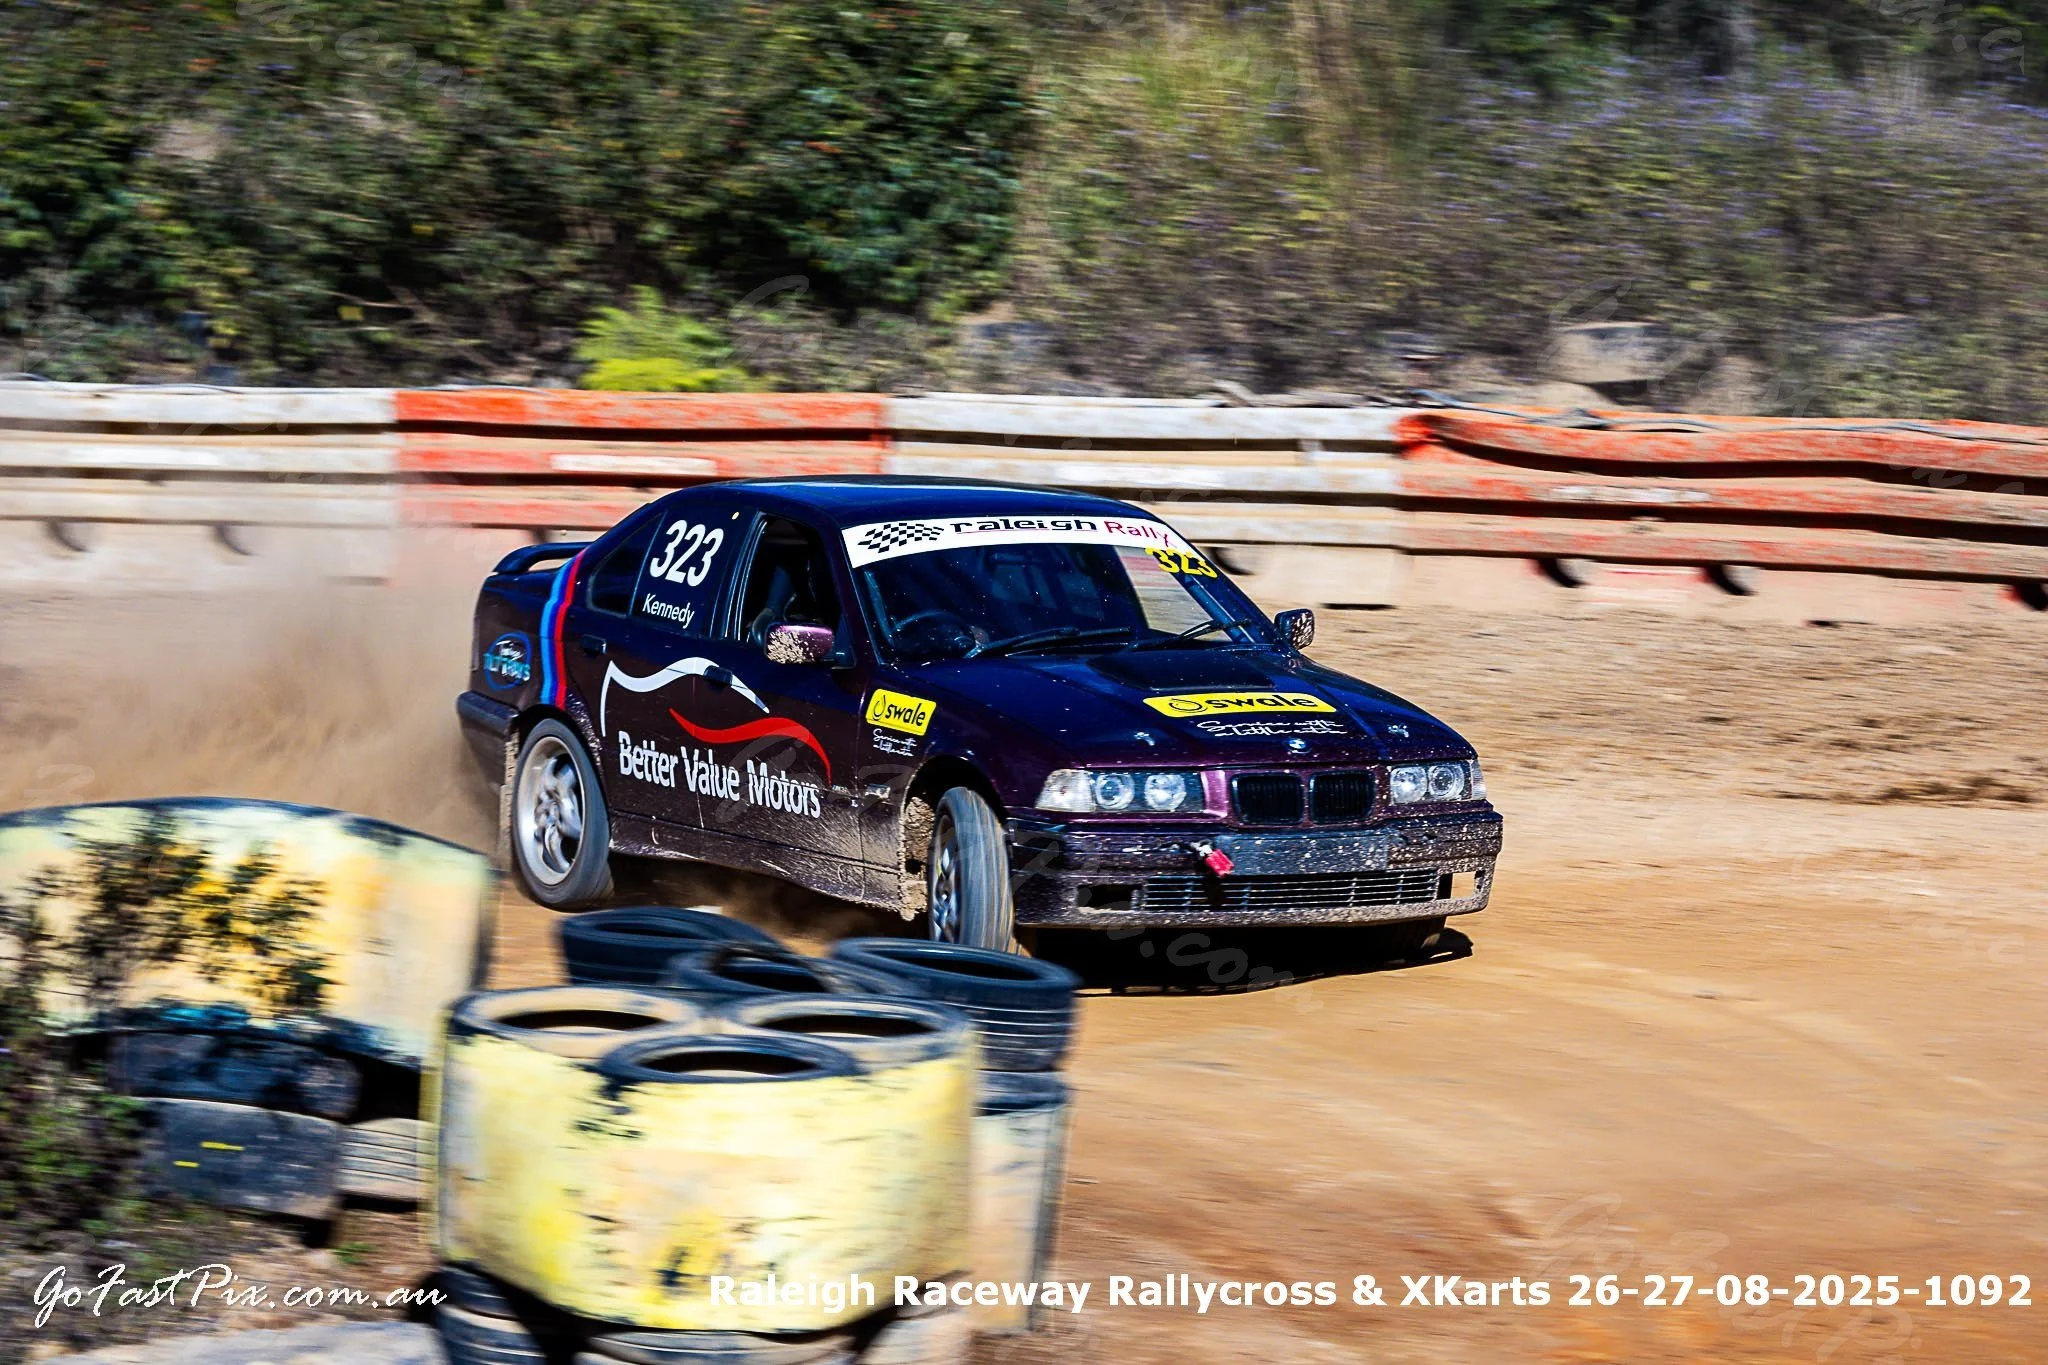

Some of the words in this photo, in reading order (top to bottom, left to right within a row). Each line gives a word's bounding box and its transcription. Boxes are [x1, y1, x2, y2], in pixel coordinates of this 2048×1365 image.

[950, 519, 1097, 533] raleigh
[1104, 520, 1173, 547] Rally
[650, 520, 724, 587] 323
[1145, 547, 1218, 579] 323
[642, 592, 695, 629] Kennedy
[885, 703, 926, 726] swale
[1205, 694, 1318, 709] swale
[618, 730, 679, 788] Better
[680, 746, 740, 802] Value
[746, 760, 821, 818] Motors
